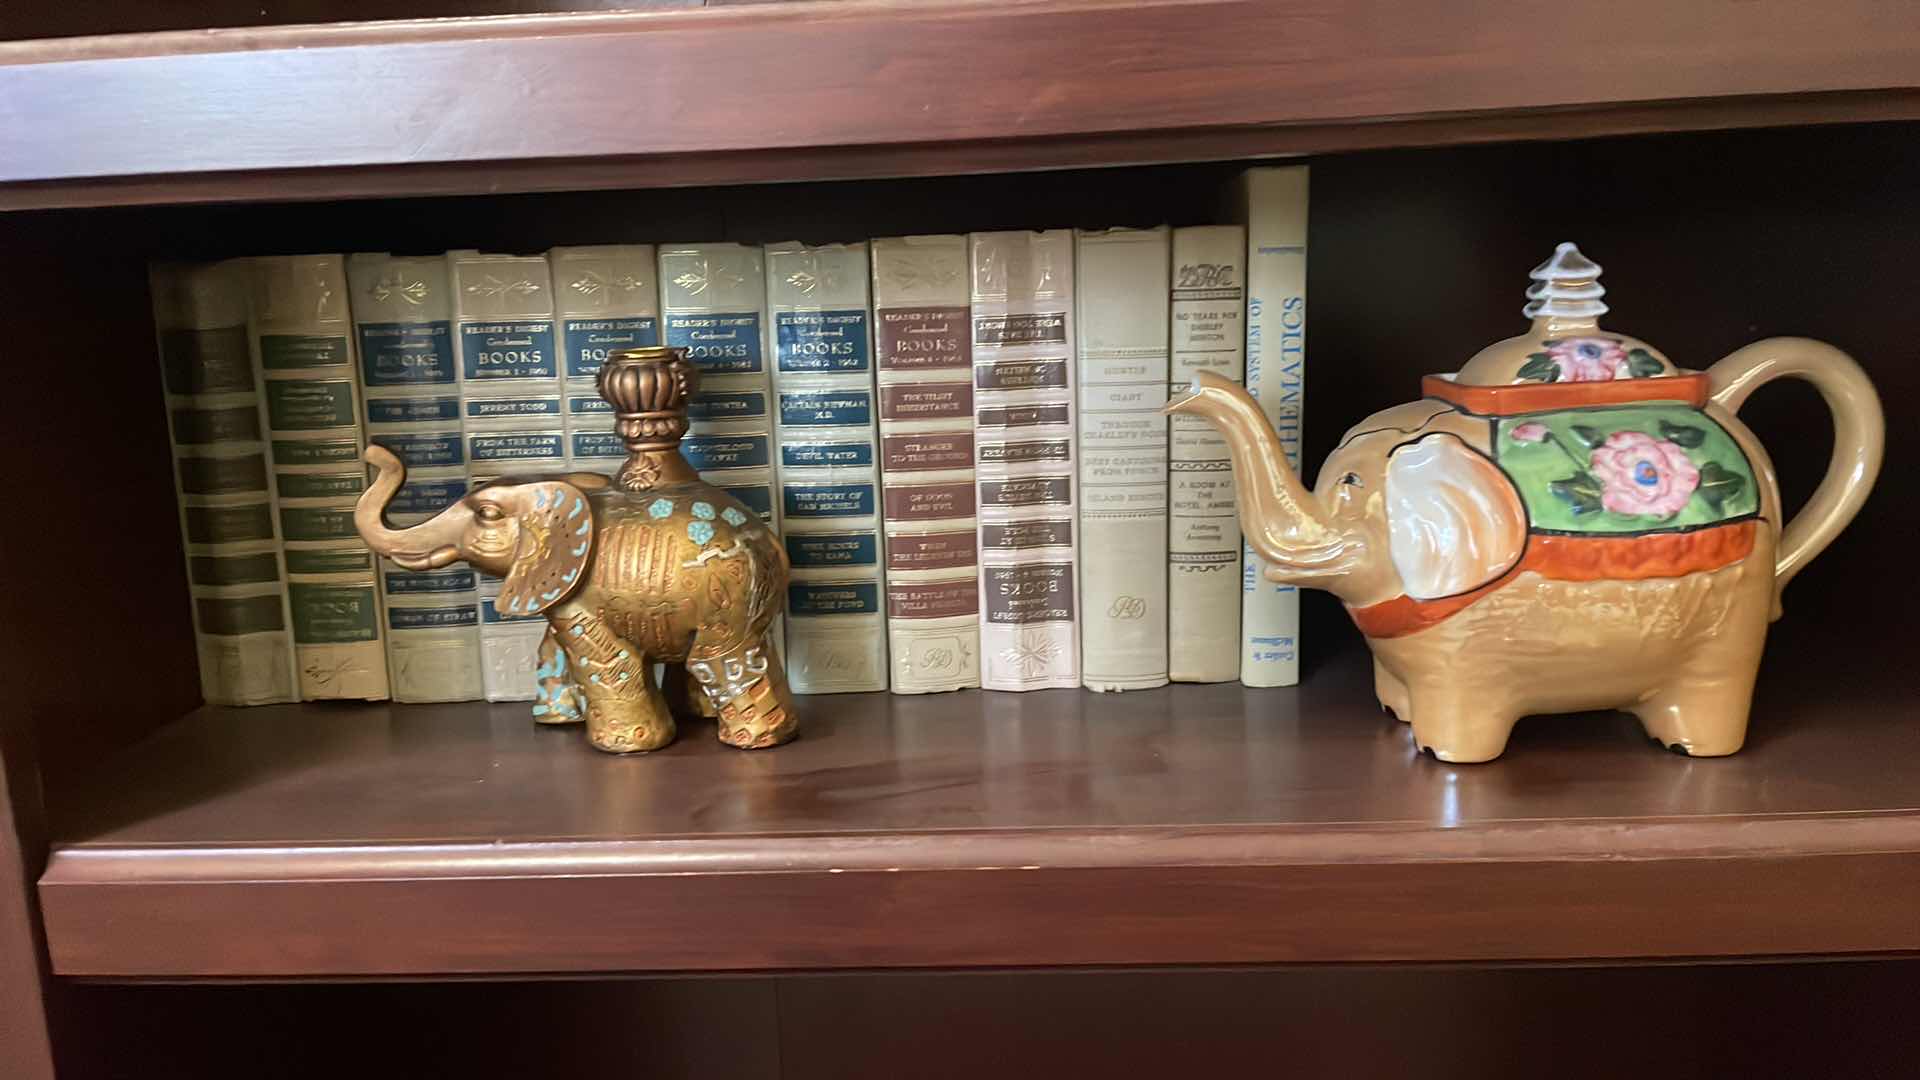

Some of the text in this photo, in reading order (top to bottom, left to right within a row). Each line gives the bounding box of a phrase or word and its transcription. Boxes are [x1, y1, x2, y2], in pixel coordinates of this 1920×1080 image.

[1250, 297, 1262, 317] OF
[791, 342, 853, 355] BOOKS
[897, 338, 957, 352] BOOKS
[479, 351, 542, 365] BOOKS
[1249, 325, 1261, 382] SYSTEM
[1279, 297, 1302, 472] THEMATICS
[904, 393, 921, 401] THE
[1109, 393, 1142, 401] GIANT
[795, 492, 813, 500] THE
[850, 491, 863, 500] OF
[1000, 580, 1059, 596] BOOKS
